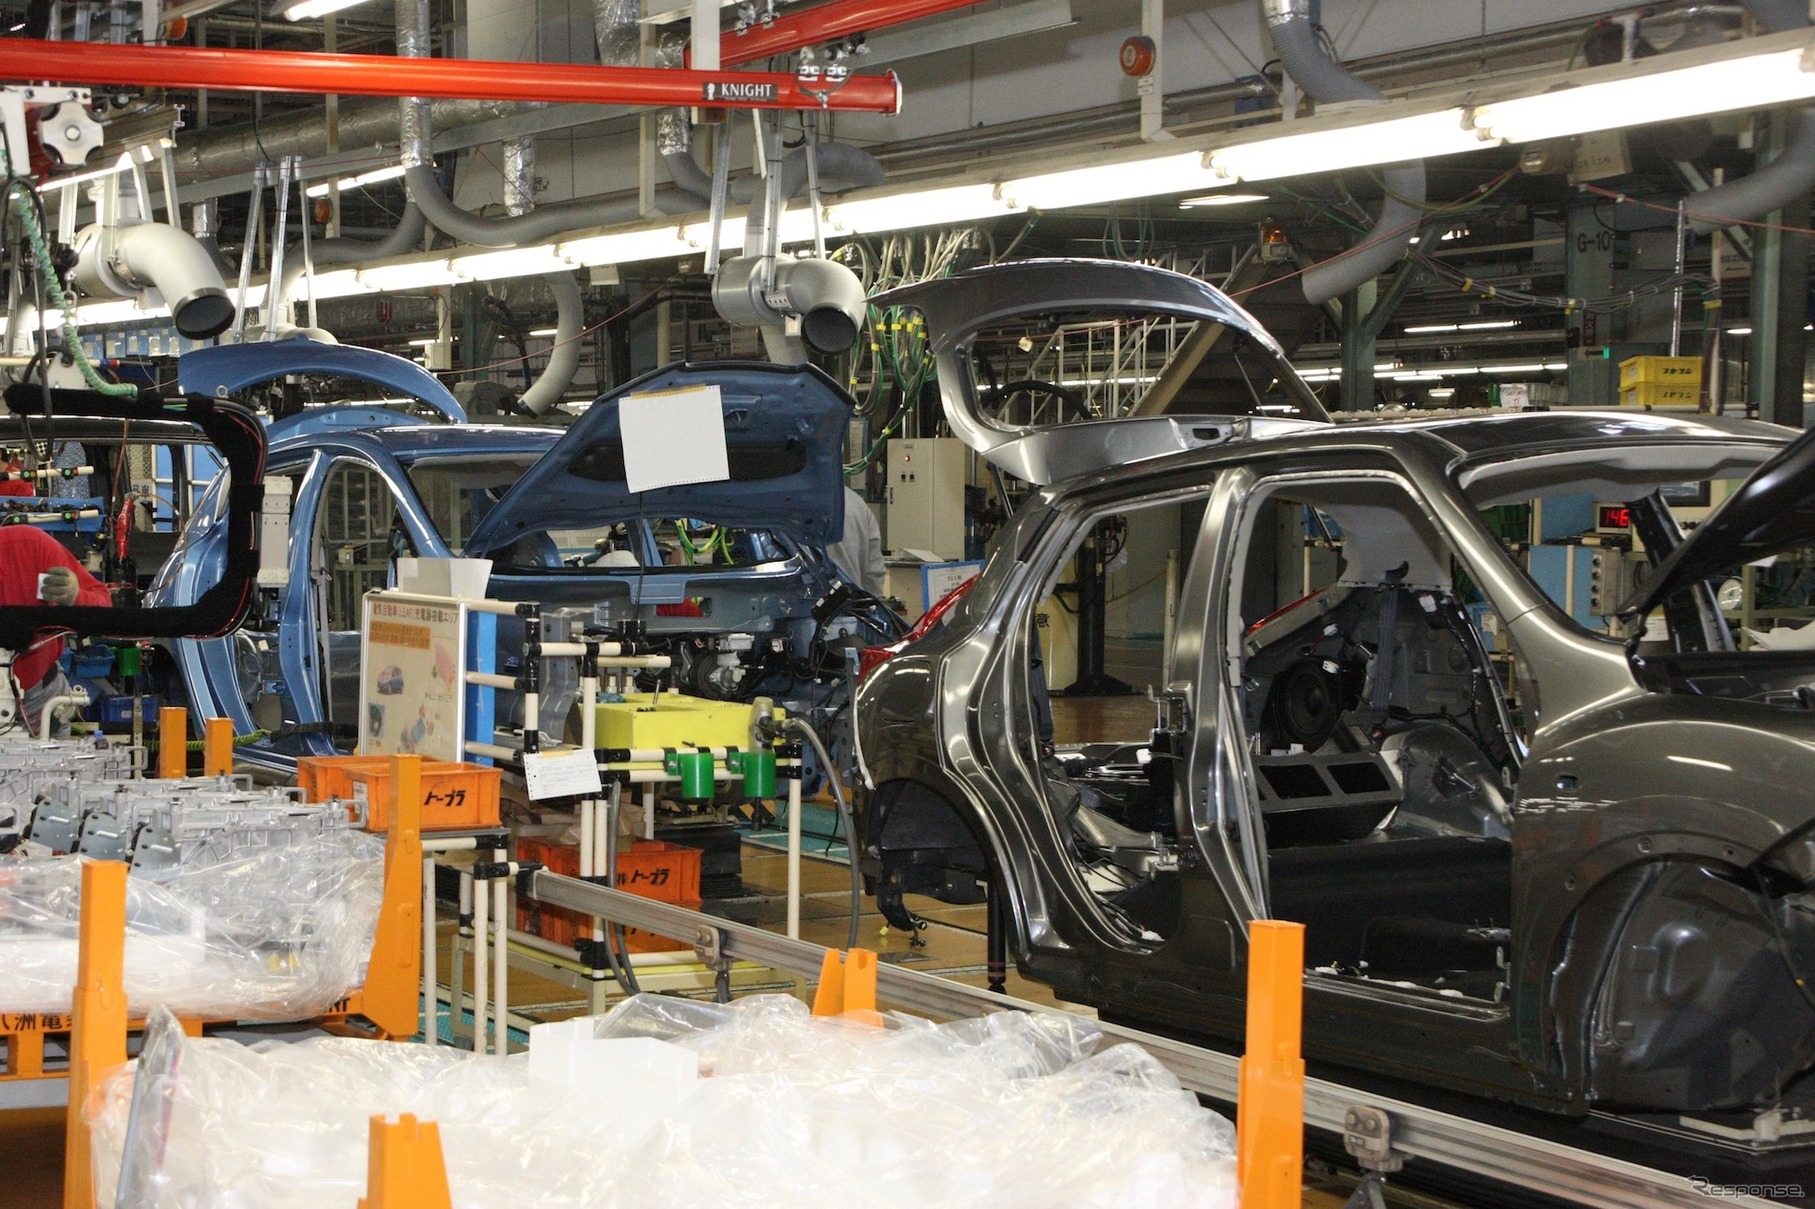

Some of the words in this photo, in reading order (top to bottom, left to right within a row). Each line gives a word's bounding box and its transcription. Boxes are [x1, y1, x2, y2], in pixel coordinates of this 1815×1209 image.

[721, 83, 772, 97] KNIGHT
[1578, 231, 1610, 253] G-10
[424, 789, 467, 807] トープラ
[631, 868, 670, 886] トープラ
